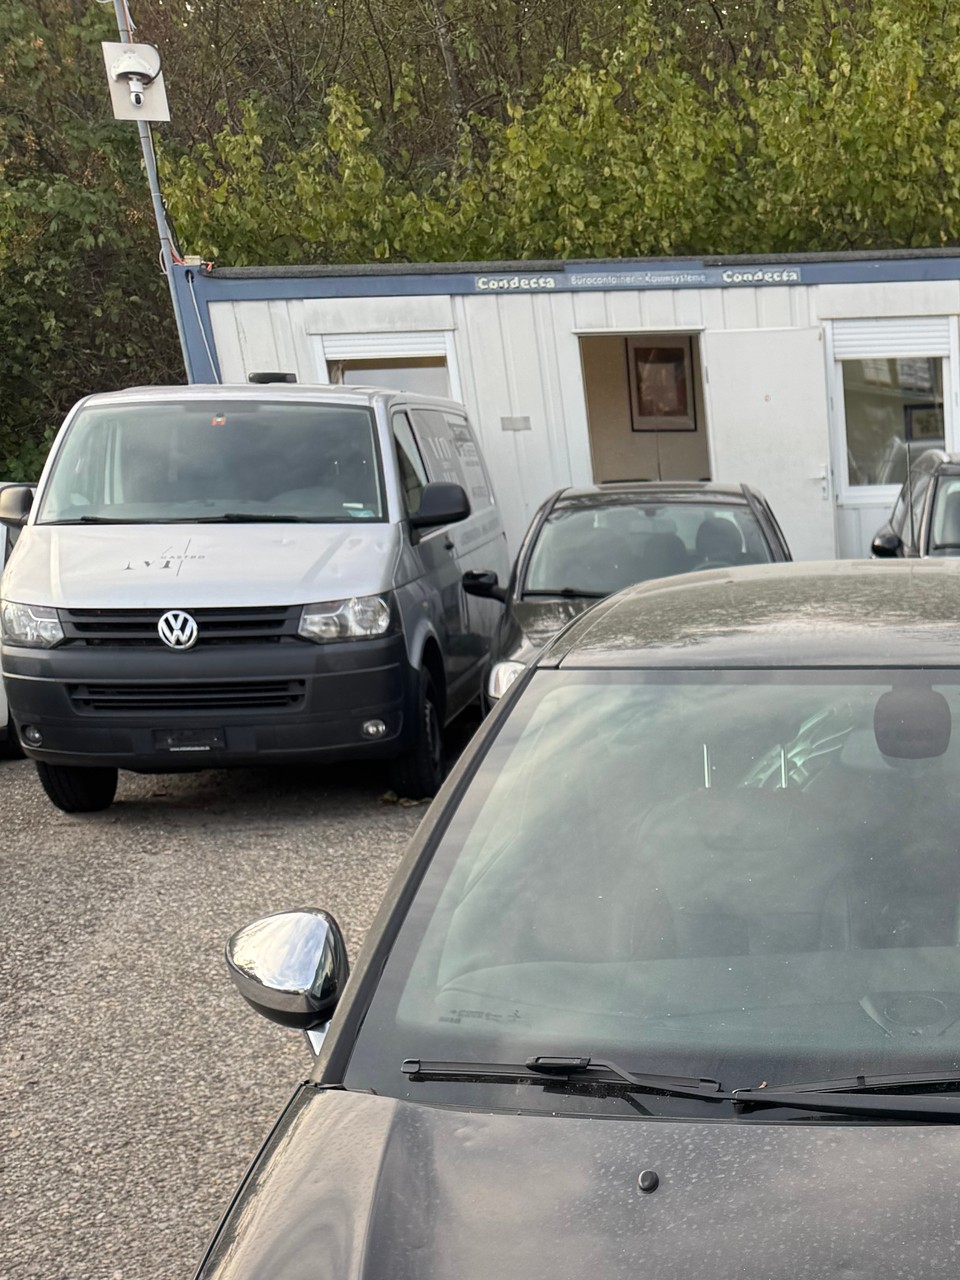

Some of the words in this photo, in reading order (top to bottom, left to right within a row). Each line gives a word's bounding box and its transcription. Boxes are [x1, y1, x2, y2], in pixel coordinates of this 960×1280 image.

[477, 276, 556, 290] Condecta
[722, 270, 798, 283] Condecta
[158, 610, 198, 649] VW
